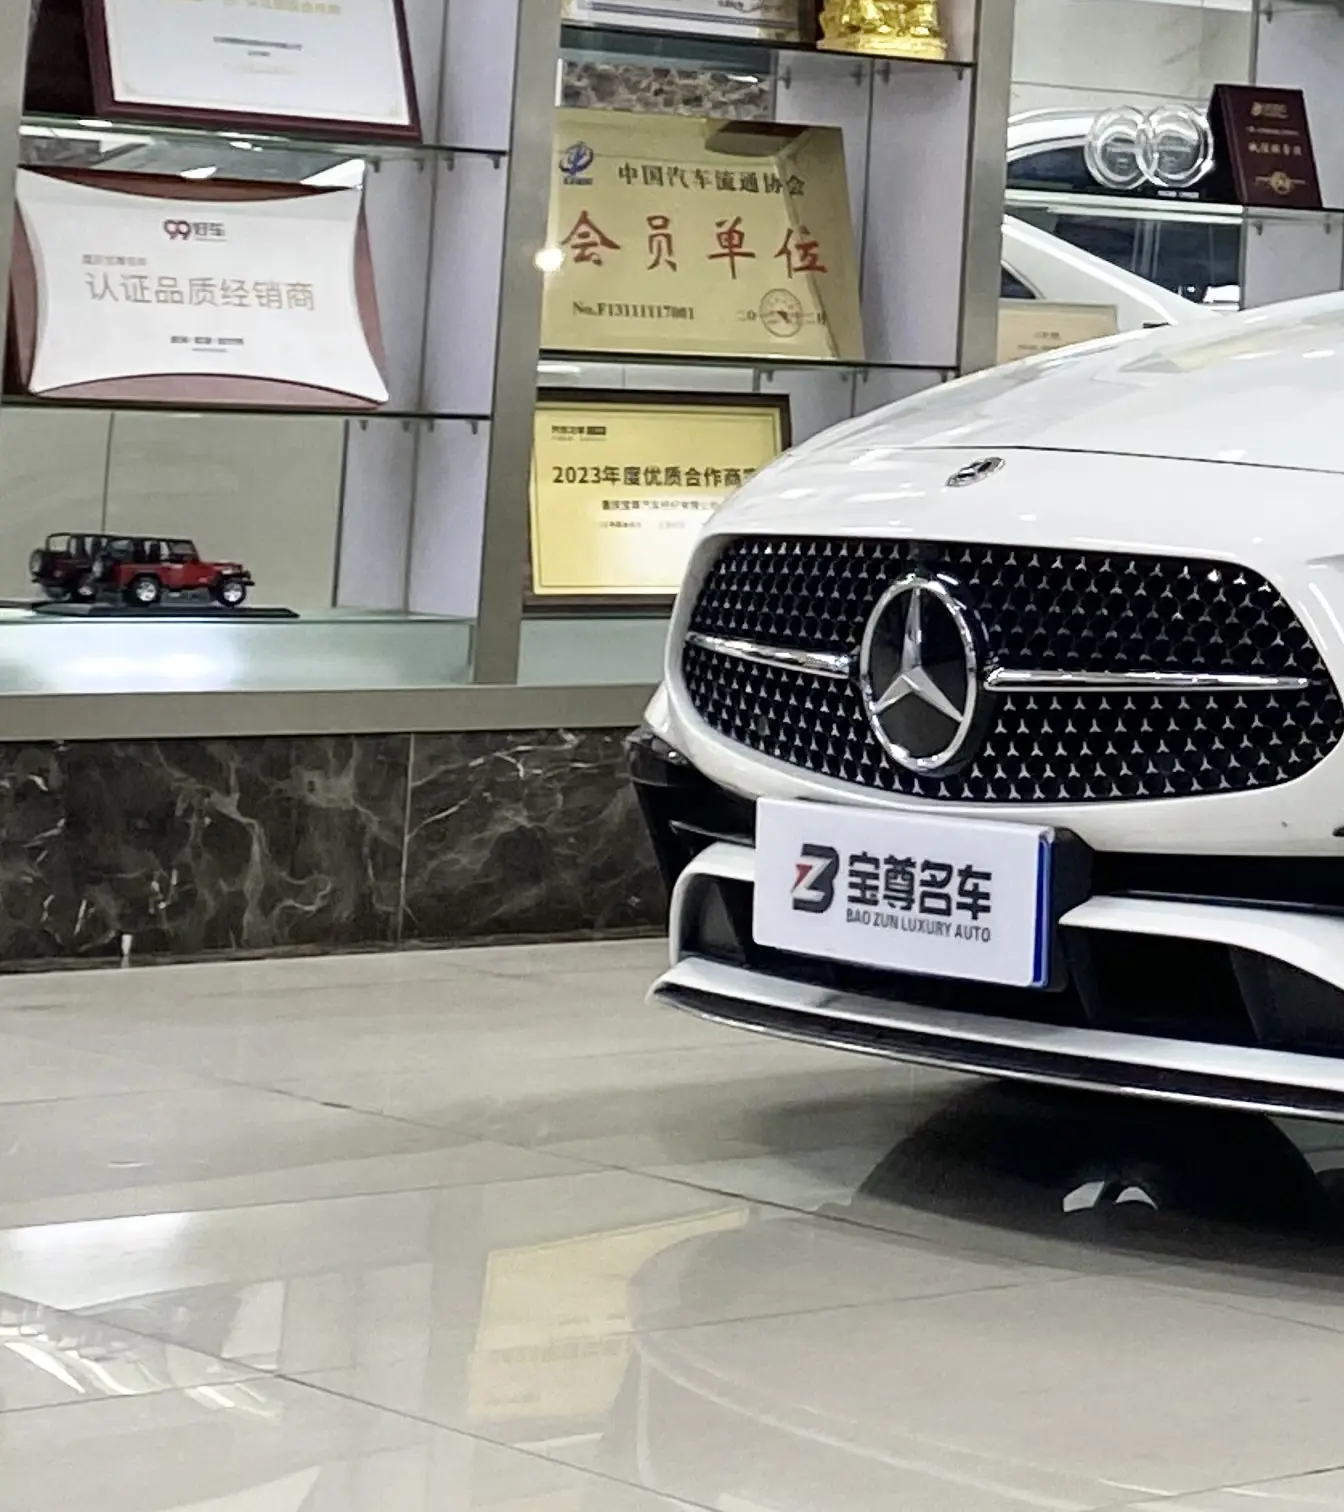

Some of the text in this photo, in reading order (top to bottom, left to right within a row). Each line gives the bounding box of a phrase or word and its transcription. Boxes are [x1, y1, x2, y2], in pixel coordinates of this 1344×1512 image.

[619, 162, 805, 197] 中国汽车流通协会
[560, 209, 828, 280] 会员单位
[85, 272, 316, 311] 认证品质经销商
[848, 851, 992, 920] 宝尊名车
[846, 908, 991, 943] BAO ZUN LUXURY AUTO
